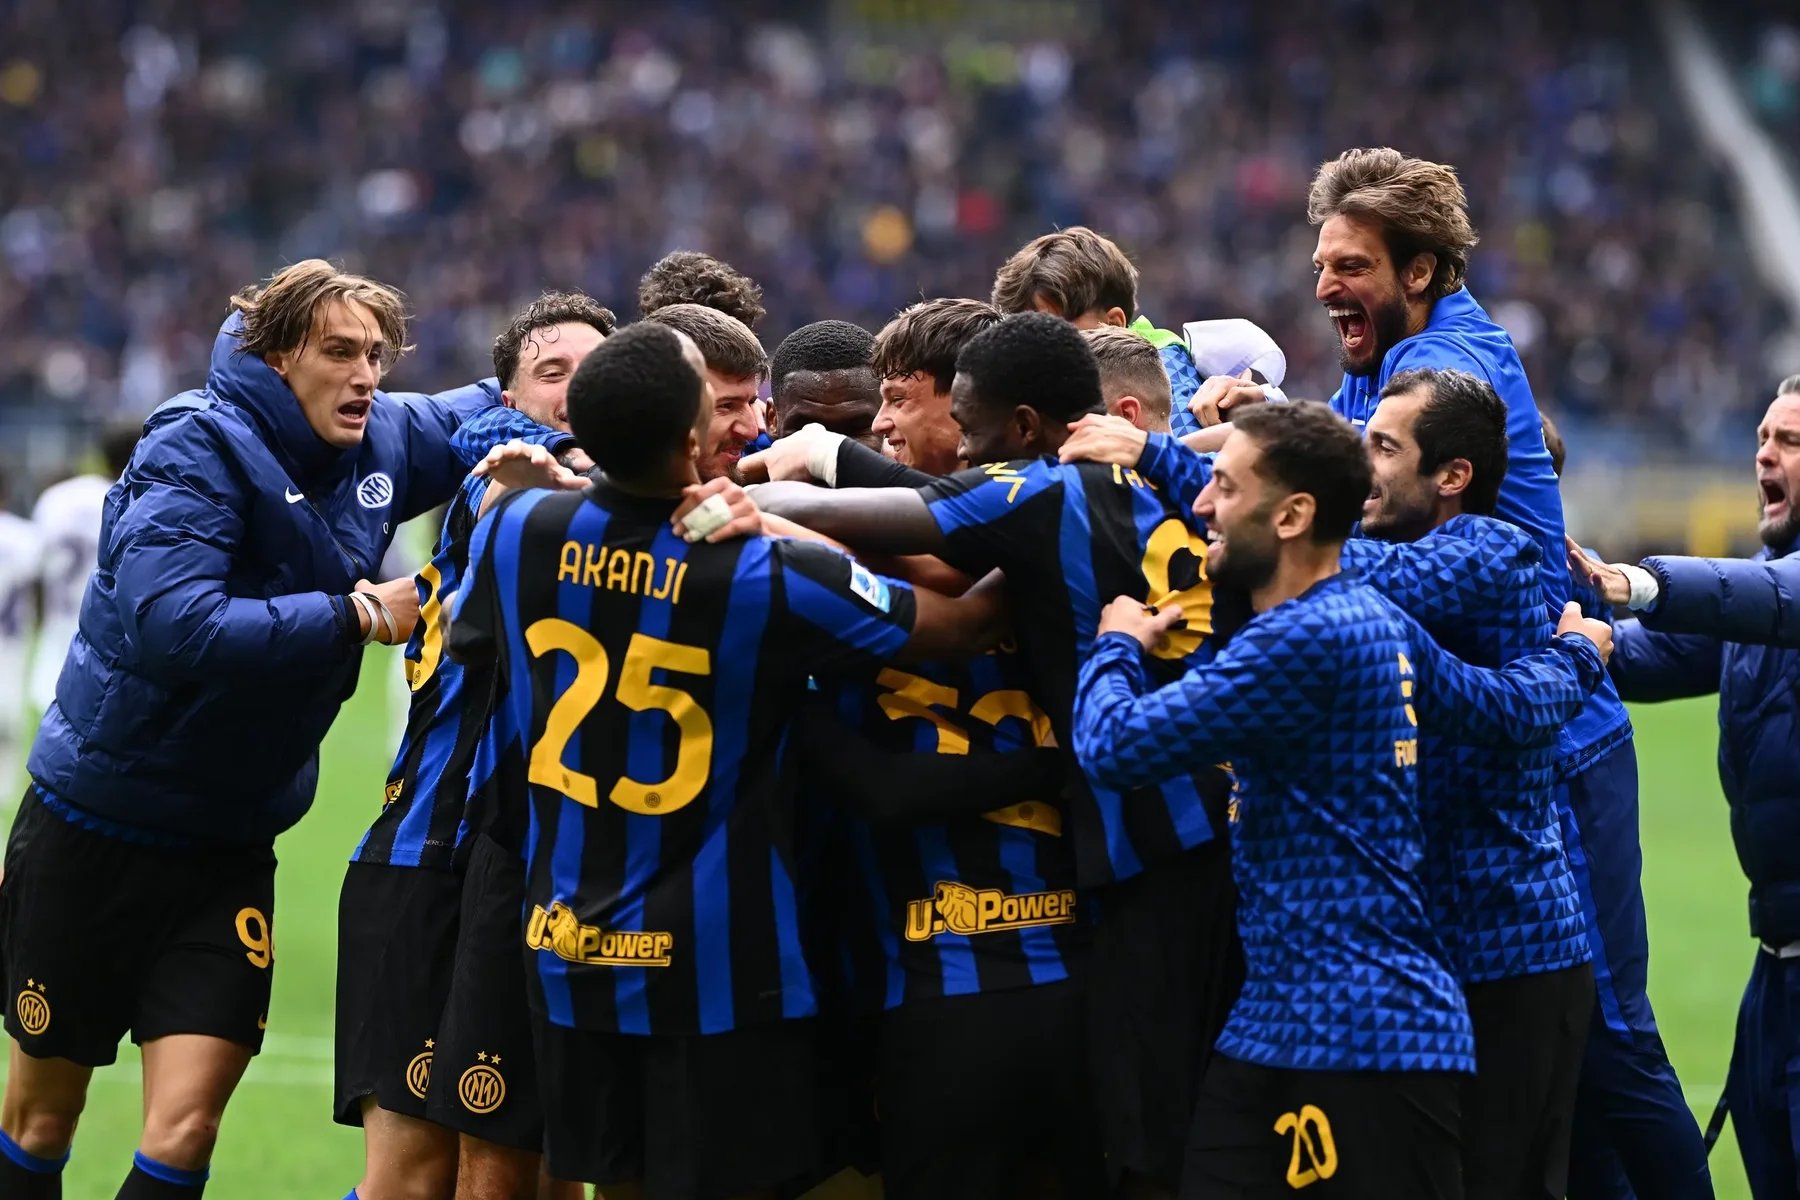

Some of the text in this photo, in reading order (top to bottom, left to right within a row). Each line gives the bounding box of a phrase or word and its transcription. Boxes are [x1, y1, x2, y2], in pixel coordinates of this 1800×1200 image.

[557, 540, 688, 605] AKANJI
[525, 617, 713, 815] 25
[234, 906, 275, 969] 9
[1274, 1104, 1338, 1189] 20
